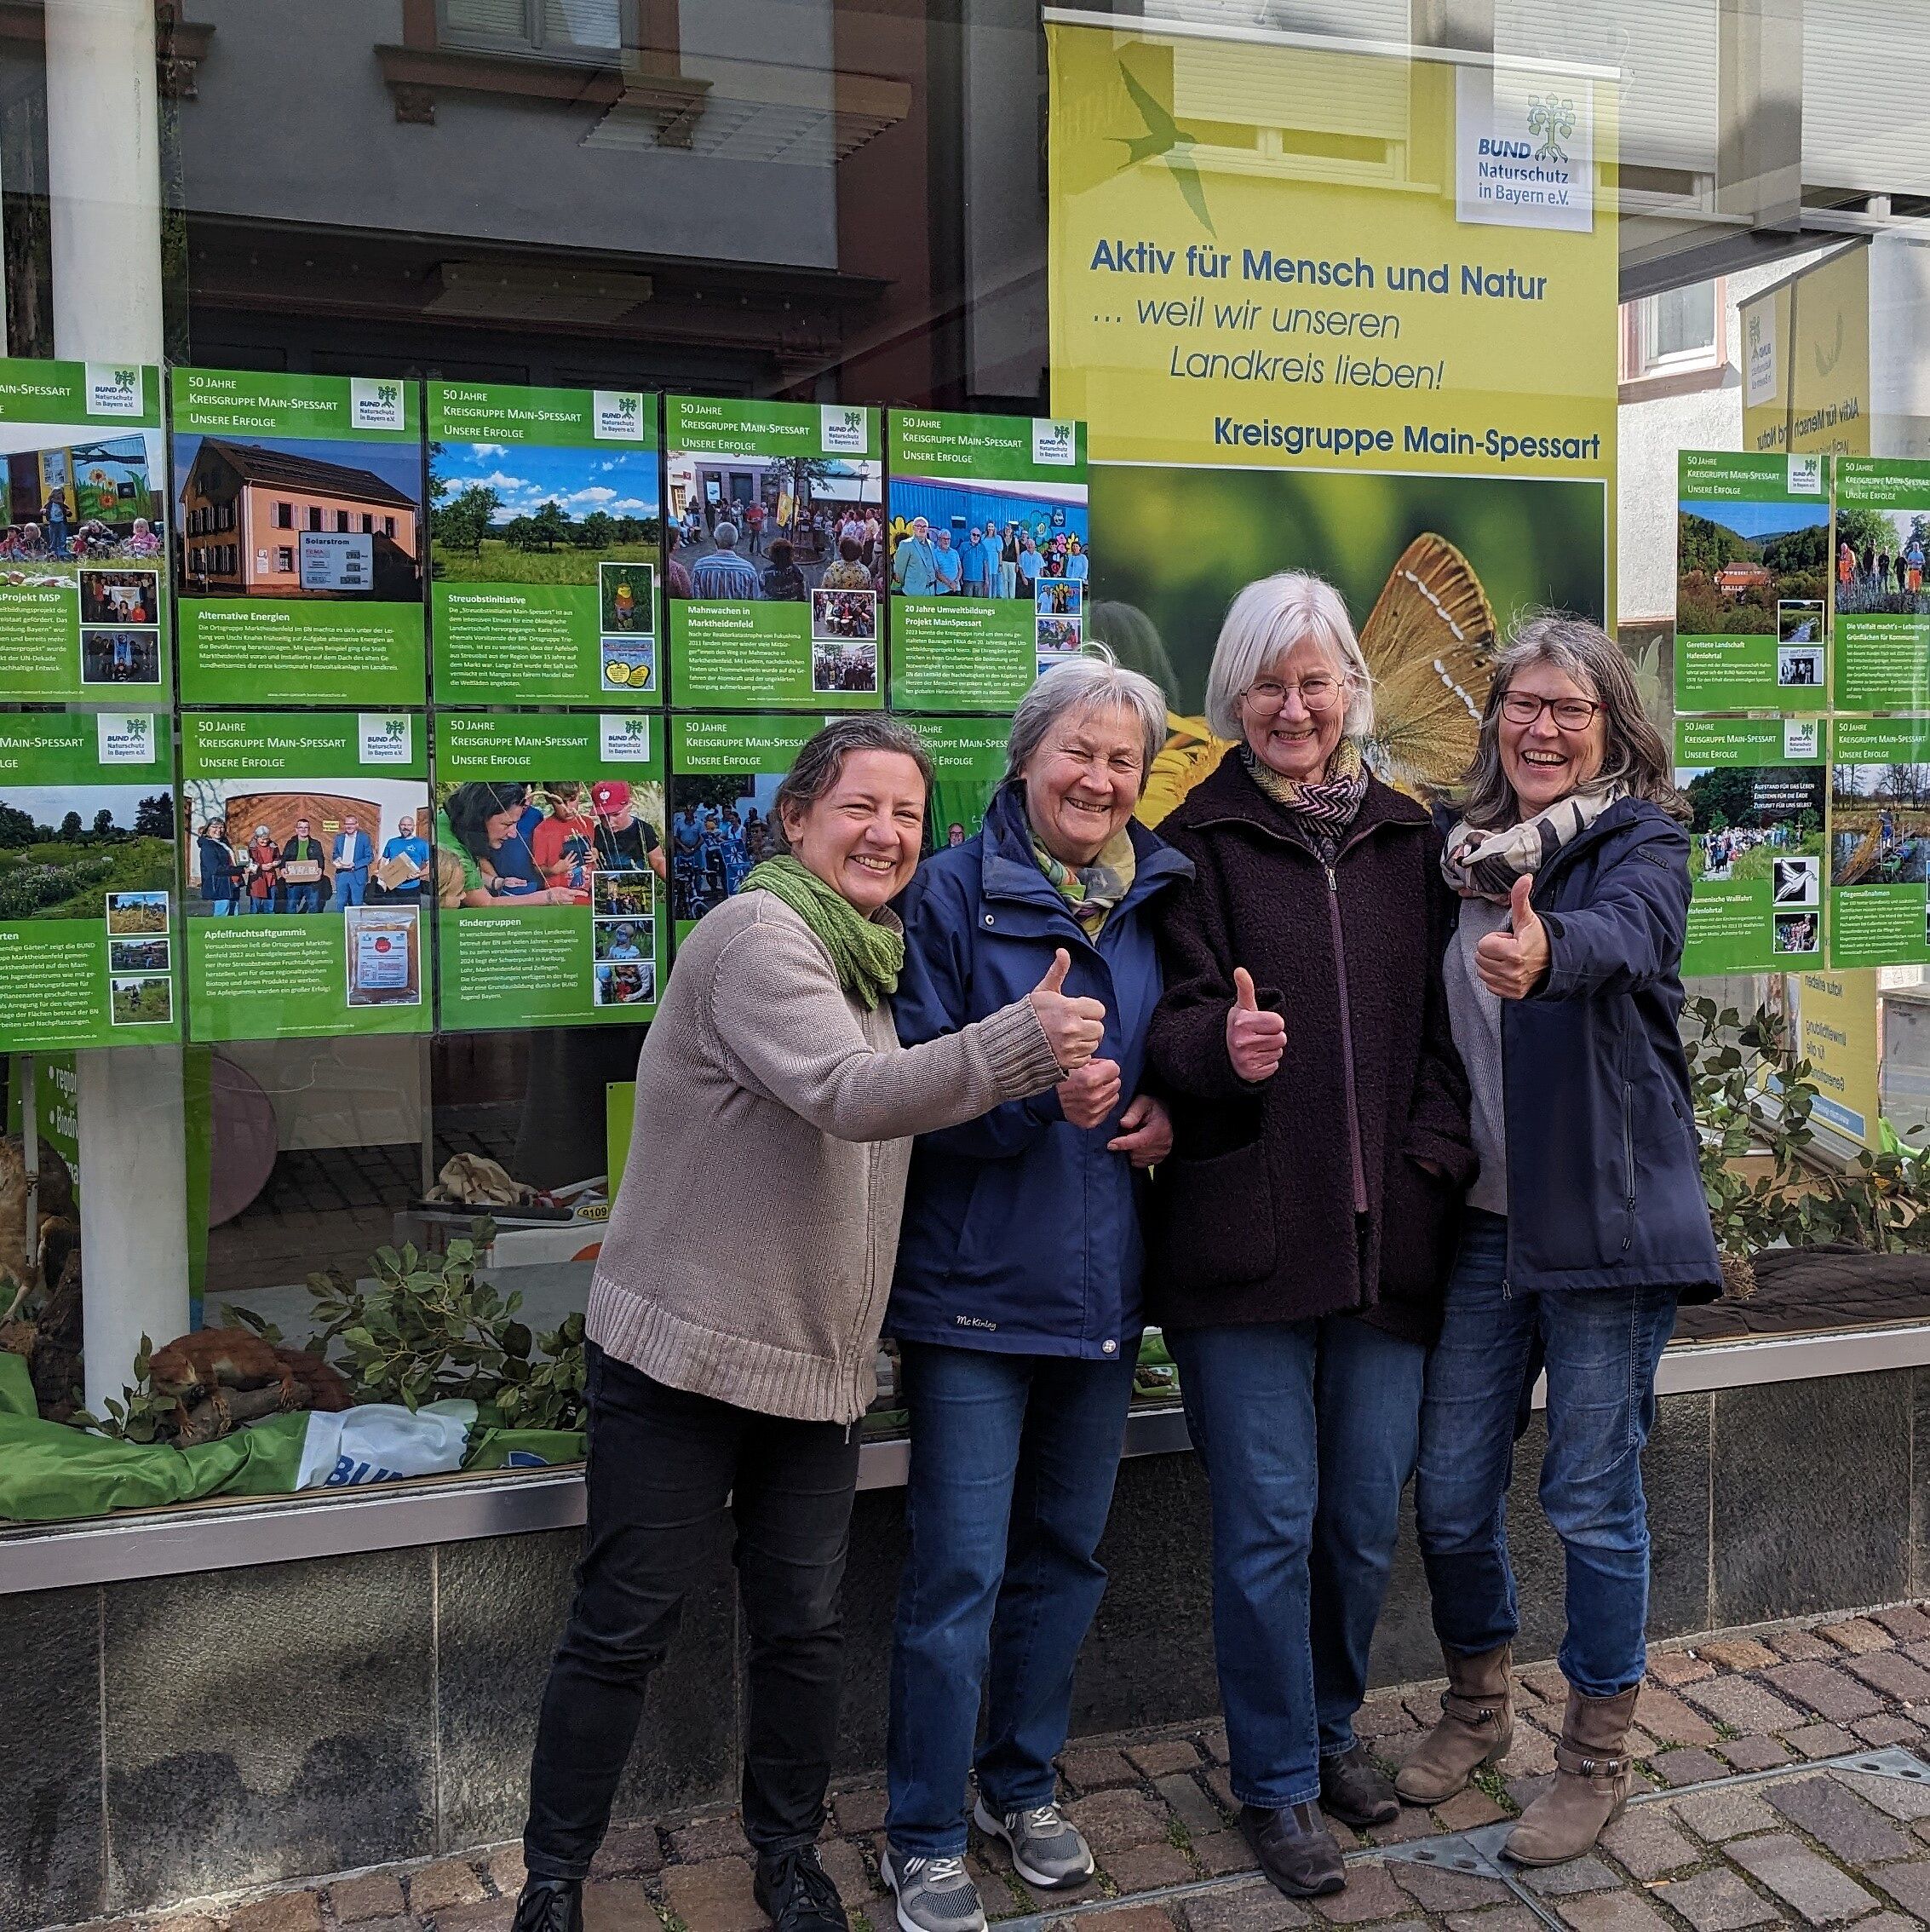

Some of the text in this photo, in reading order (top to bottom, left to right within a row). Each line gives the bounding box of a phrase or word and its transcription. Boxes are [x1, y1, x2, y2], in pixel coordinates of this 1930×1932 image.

[1478, 138, 1531, 159] BUND
[1479, 161, 1569, 184] Naturschutz
[1479, 181, 1569, 206] in Bayern e.V.
[1089, 239, 1548, 301] Aktiv für Mensch und Natur
[1137, 296, 1205, 328] weil
[1214, 299, 1262, 331] wir
[1272, 308, 1400, 339] unseren
[1170, 345, 1445, 390] Landkreis lieben!
[188, 377, 237, 389] 50 JAHRE
[0, 384, 72, 396] AIN-SPESSART
[443, 389, 488, 402] 50 JAHRE
[189, 393, 338, 411] KREISGRUPPE MAIN-SPESSART
[443, 405, 583, 423] KREISGRUPPE MAIN-SPESSART
[681, 403, 722, 416] 50 JAHRE
[190, 412, 276, 428] UNSERE ERFOLGE
[902, 417, 942, 429] 50 JAHRE
[444, 424, 525, 439] UNSERE ERFOLGE
[681, 418, 810, 435] KREISGRUPPE MAIN-SPESSART
[681, 437, 756, 451] UNSERE ERFOLGE
[902, 432, 1023, 448] KREISGRUPPE MAIN-SPESSART
[1215, 417, 1600, 461] Kreisgruppe Main-Spessart
[903, 450, 973, 463] UNSERE ERFOLGE
[1687, 456, 1717, 466] 50 JAHRE
[1845, 462, 1874, 472] 50 JAHRE
[1687, 469, 1729, 480] KREISGRUPPE
[1729, 470, 1780, 480] MAIN-SPESSART
[1885, 476, 1930, 486] MAIN-SPESSAR
[1687, 485, 1741, 495] UNSERE ERFOLGE
[1845, 490, 1896, 500] UNSERE ERFOLGE
[38, 593, 61, 602] MSP
[448, 594, 526, 604] Streuobstinitiative
[687, 606, 741, 615] Mahnwachen
[915, 605, 936, 613] Jahre
[936, 606, 996, 617] Umweltbildungs
[198, 611, 290, 623] Alternative Energien
[688, 618, 754, 629] Marktheidenfeld
[905, 618, 982, 628] Projekt MainSpessart
[198, 721, 246, 732] 50 JAHRE
[451, 720, 496, 731] 50 JAHRE
[686, 722, 727, 733] 50 JAHRE
[918, 724, 943, 733] JAHRE
[1685, 722, 1715, 731] 50 JAHRE
[1838, 722, 1868, 732] 50 JAHRE
[0, 737, 84, 748] MAIN-SPESSART
[198, 737, 347, 748] KREISGRUPPE MAIN-SPESSART
[451, 736, 589, 746] KREISGRUPPE MAIN-SPESSART
[686, 737, 809, 747] KREISGRUPPE MAIN-SPESSA
[959, 739, 1008, 748] MAIN-SPESS
[1684, 733, 1777, 744] KREISGRUPPE MAIN-SPESSART
[1838, 734, 1927, 745] KREISGRUPPE MAIN-SPESSART
[114, 749, 135, 757] Bayern
[1684, 750, 1738, 759] UNSERE ERFOLGE
[1839, 750, 1890, 759] UNSERE ERFOLGE
[199, 756, 285, 768] UNSERE ERFOLGE
[451, 755, 531, 765] UNSERE ERFOLGE
[686, 755, 762, 766] UNSERE ERFOLGE
[939, 756, 974, 766] ERFOLGE
[459, 918, 521, 929] Kindergruppen
[204, 928, 307, 940] Apfelfruchtsaftgummis
